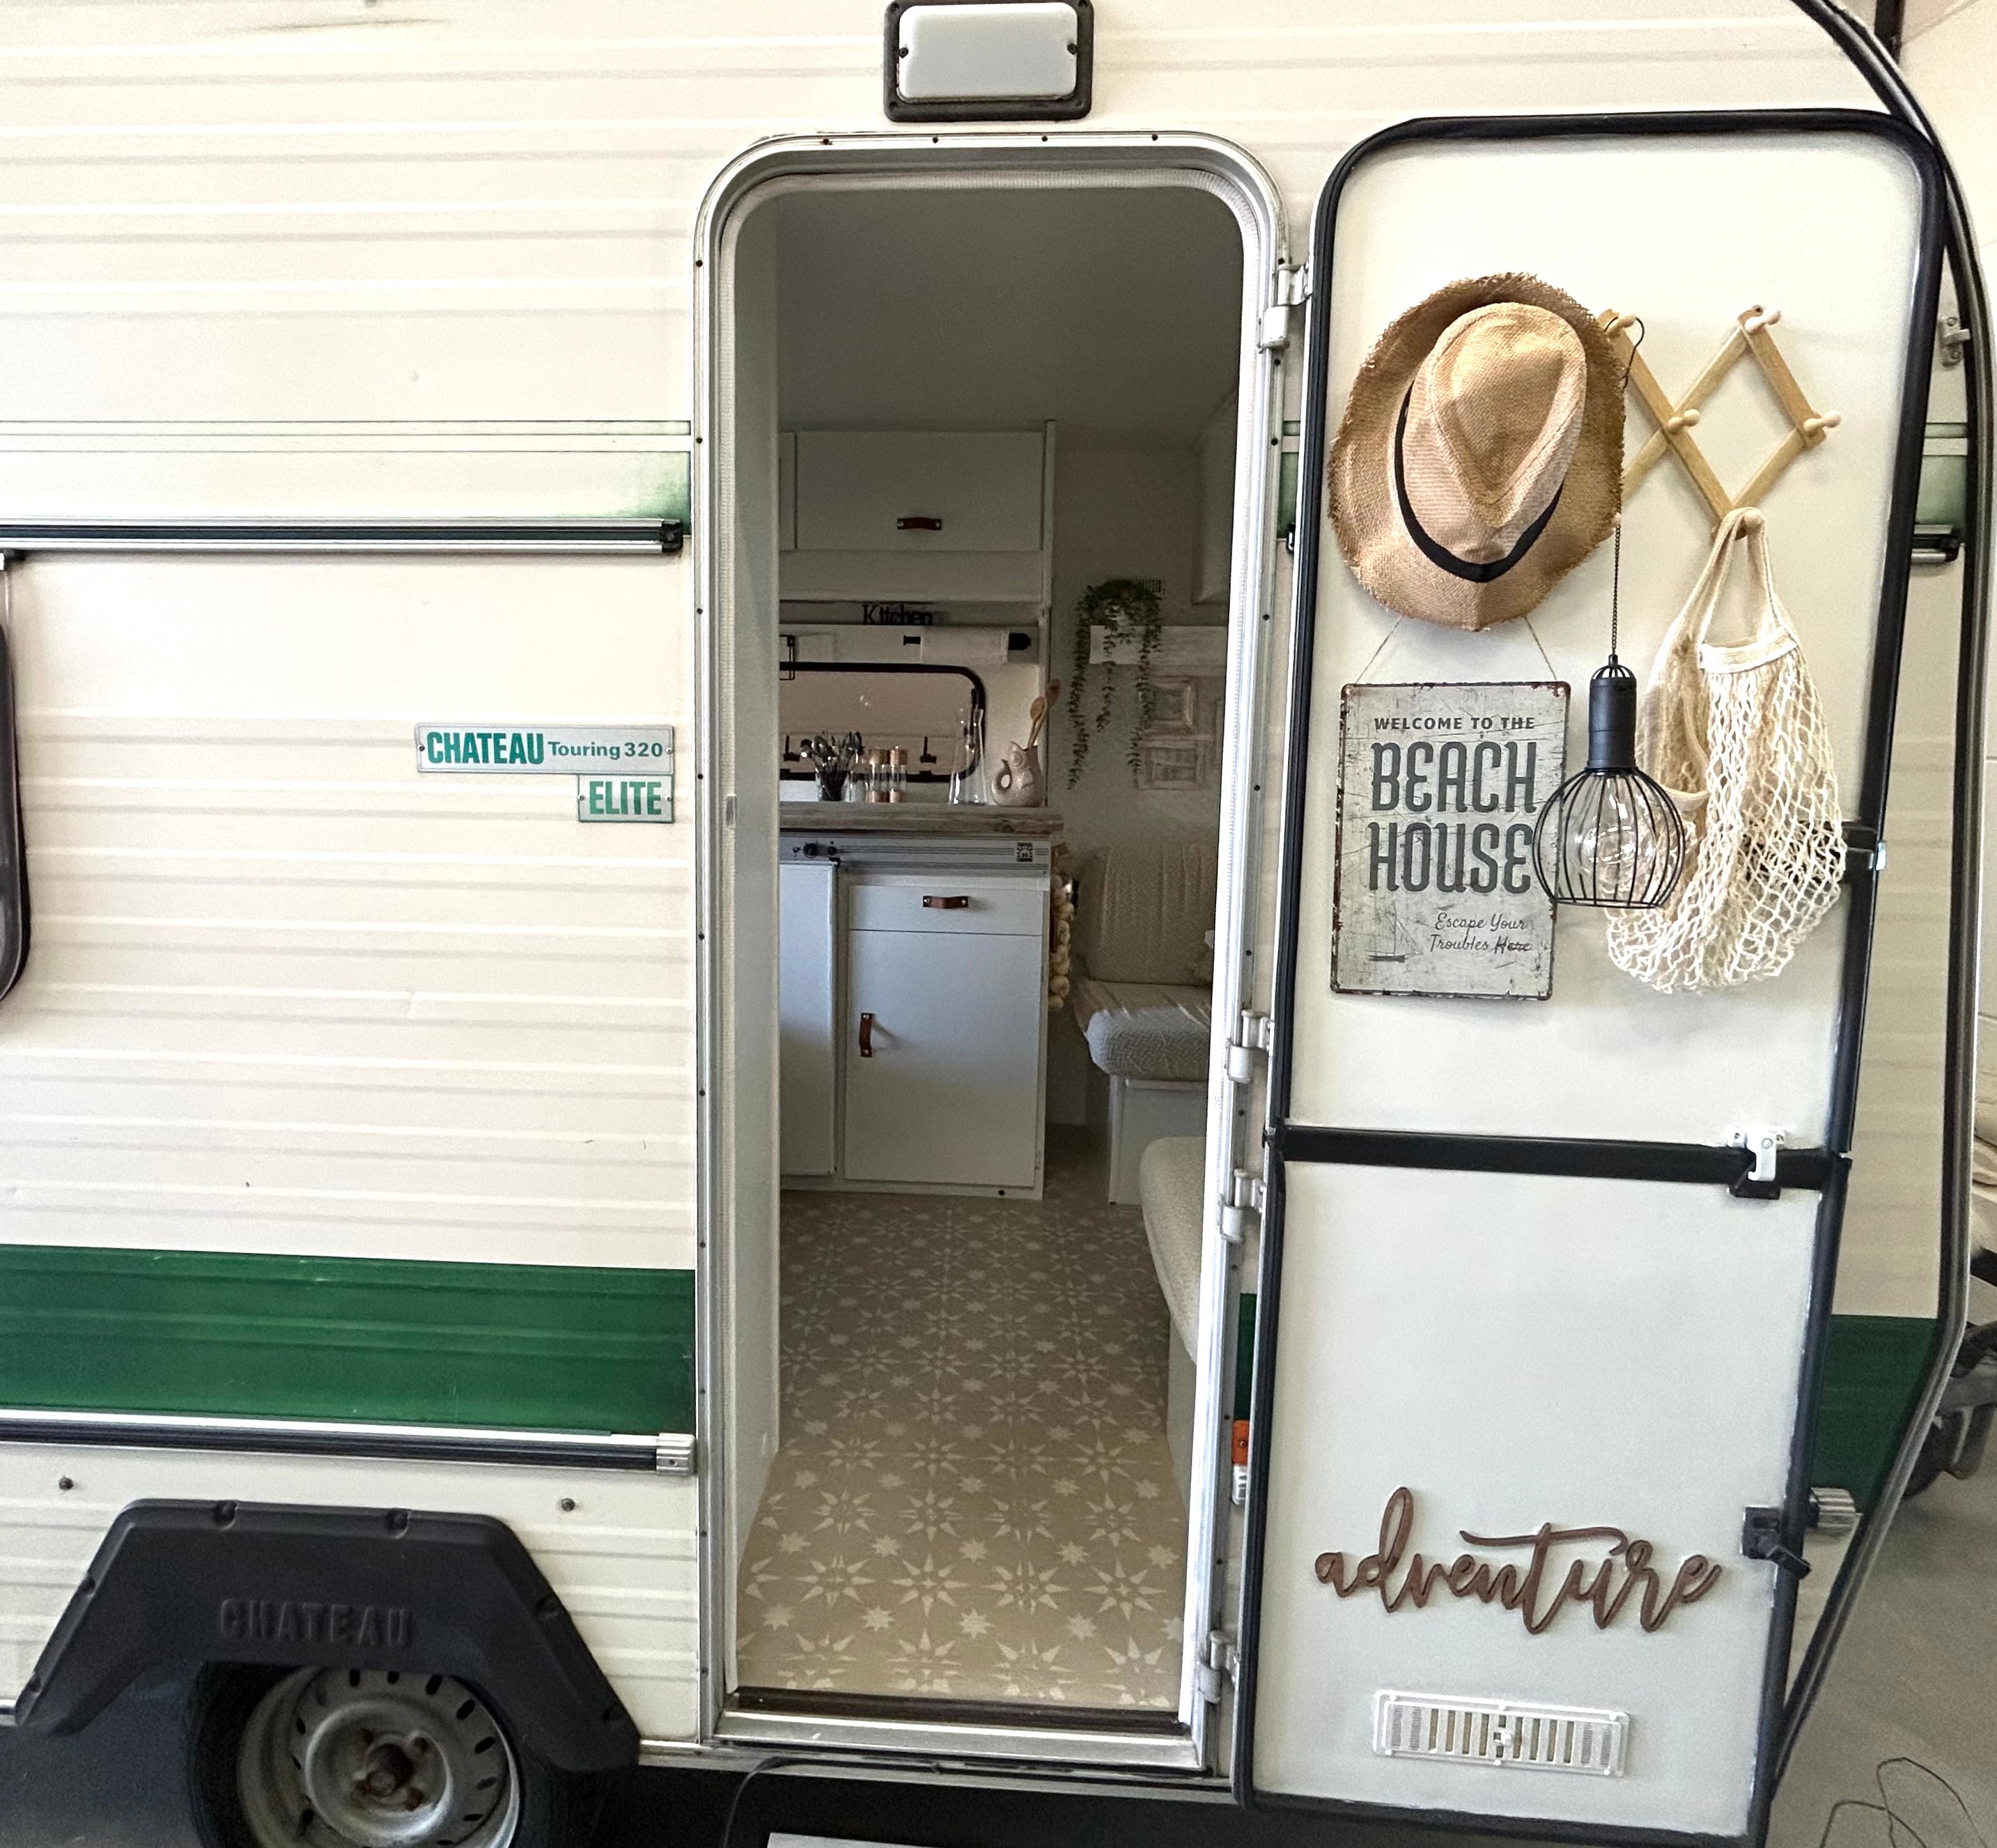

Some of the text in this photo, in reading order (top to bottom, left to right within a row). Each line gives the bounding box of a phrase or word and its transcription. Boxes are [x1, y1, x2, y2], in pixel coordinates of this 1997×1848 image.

[861, 603, 933, 626] Kitchen
[1374, 717, 1535, 730] WELCOME TO THE
[426, 731, 663, 765] CHATEAU Touring 320
[1370, 740, 1537, 814] BEACH
[589, 781, 662, 816] ELITE
[1367, 821, 1534, 894] HOUSE
[1435, 912, 1528, 934] Escape Your
[1430, 933, 1489, 952] Troubles
[1314, 1486, 1723, 1634] adventure
[220, 1599, 413, 1647] CHATEAU
